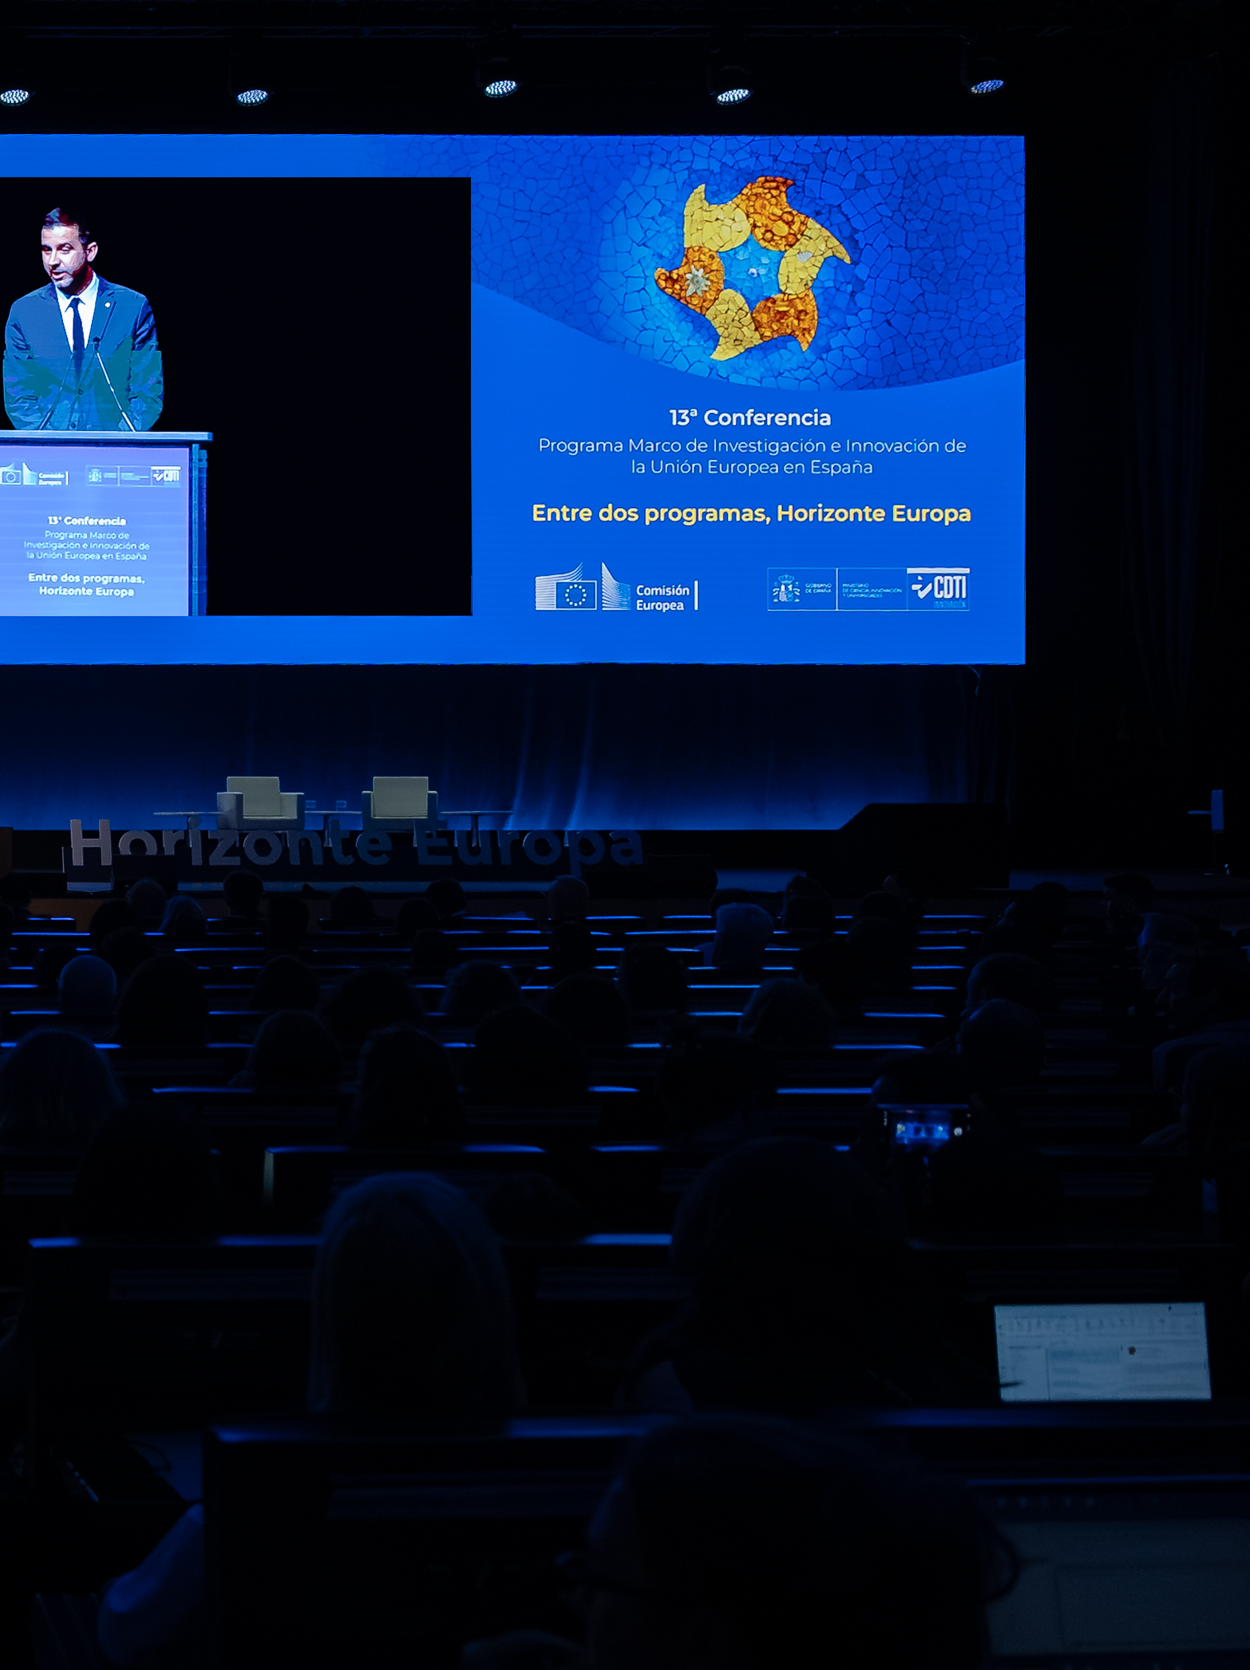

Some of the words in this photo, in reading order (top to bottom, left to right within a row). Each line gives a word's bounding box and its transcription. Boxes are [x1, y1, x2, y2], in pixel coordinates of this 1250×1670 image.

[669, 409, 698, 426] 13ª
[704, 408, 832, 426] Conferencia
[539, 438, 624, 456] Programa
[629, 438, 682, 453] Marco
[686, 437, 708, 453] de
[713, 438, 826, 456] Investigación
[830, 441, 842, 453] e
[846, 438, 940, 453] Innovación
[944, 438, 967, 453] de
[632, 459, 646, 474] la
[651, 459, 703, 474] Unión
[708, 459, 779, 477] Europea
[784, 462, 805, 474] en
[810, 459, 873, 477] España
[64, 516, 127, 526] Conferencia
[532, 503, 593, 522] Entre
[598, 503, 639, 522] dos
[645, 506, 771, 526] programas,
[778, 503, 886, 522] Horizonte
[892, 504, 972, 526] Europa
[45, 531, 87, 541] Programa
[89, 531, 117, 540] Marco
[118, 532, 130, 540] de
[23, 541, 81, 552] Investigación
[89, 541, 137, 551] Innovación
[138, 542, 150, 551] de
[36, 551, 63, 560] Unión
[64, 552, 101, 561] Europea
[102, 553, 114, 561] en
[115, 551, 148, 561] España
[28, 573, 59, 583] Entre
[60, 573, 81, 583] dos
[39, 586, 94, 596] Horizonte
[95, 587, 135, 597] Europa
[636, 584, 690, 597] Comisión
[934, 575, 967, 599] CDTI
[636, 599, 685, 613] Europea
[69, 818, 393, 867] Horizonte
[412, 819, 644, 878] Europa
